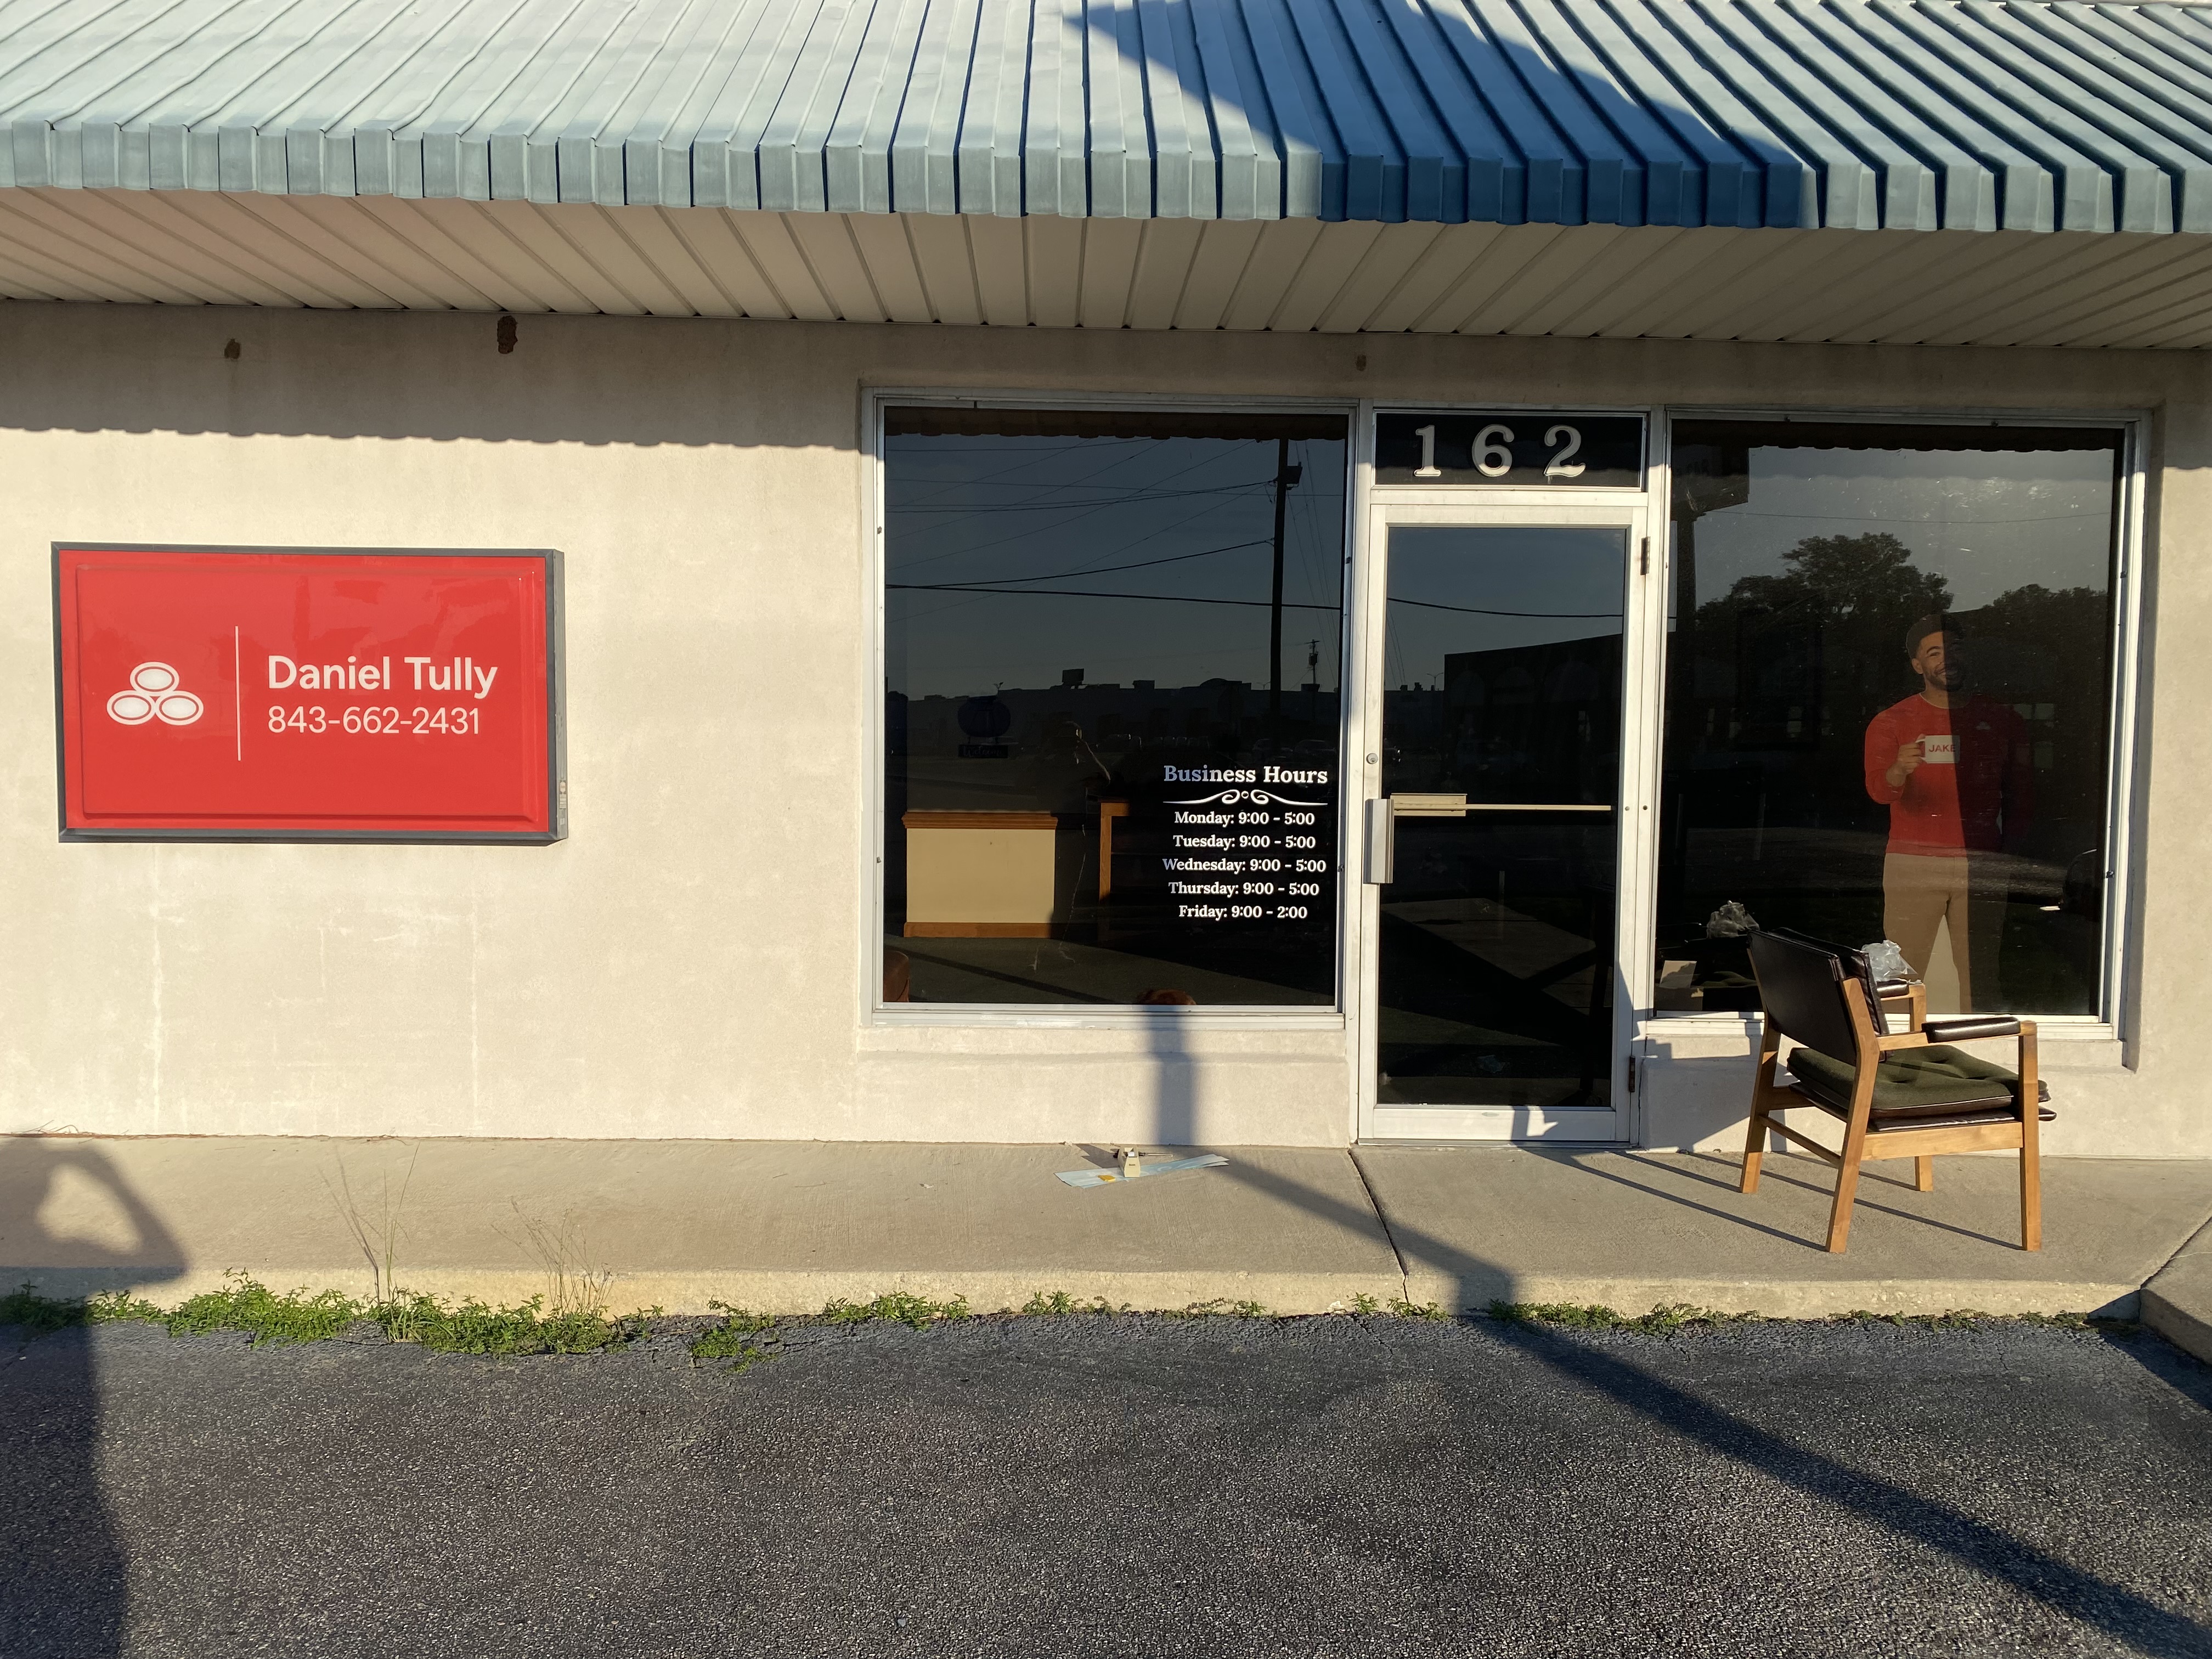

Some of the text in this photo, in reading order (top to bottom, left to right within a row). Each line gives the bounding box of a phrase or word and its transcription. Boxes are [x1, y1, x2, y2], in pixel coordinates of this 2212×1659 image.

[1413, 423, 1586, 478] 162
[268, 655, 498, 699] Daniel Tully
[268, 705, 479, 735] 843-662-2431
[1164, 764, 1328, 784] Business Hours
[1174, 811, 1234, 827] Monday:
[1238, 812, 1269, 825] 9:00
[1284, 811, 1316, 826] 5:00
[1172, 834, 1235, 851] Tuesday:
[1239, 835, 1271, 848] 9:00
[1285, 835, 1316, 849] 5:00
[1162, 857, 1246, 874] Wednesday:
[1250, 859, 1281, 872] 9:00
[1295, 859, 1327, 872] 5:00
[1167, 881, 1239, 899] Thursday:
[1243, 882, 1274, 895] 9:00
[1289, 882, 1320, 896] 5:00
[1178, 904, 1228, 921] Friday:
[1231, 906, 1262, 918] 9:00
[1277, 906, 1308, 919] 2:00
